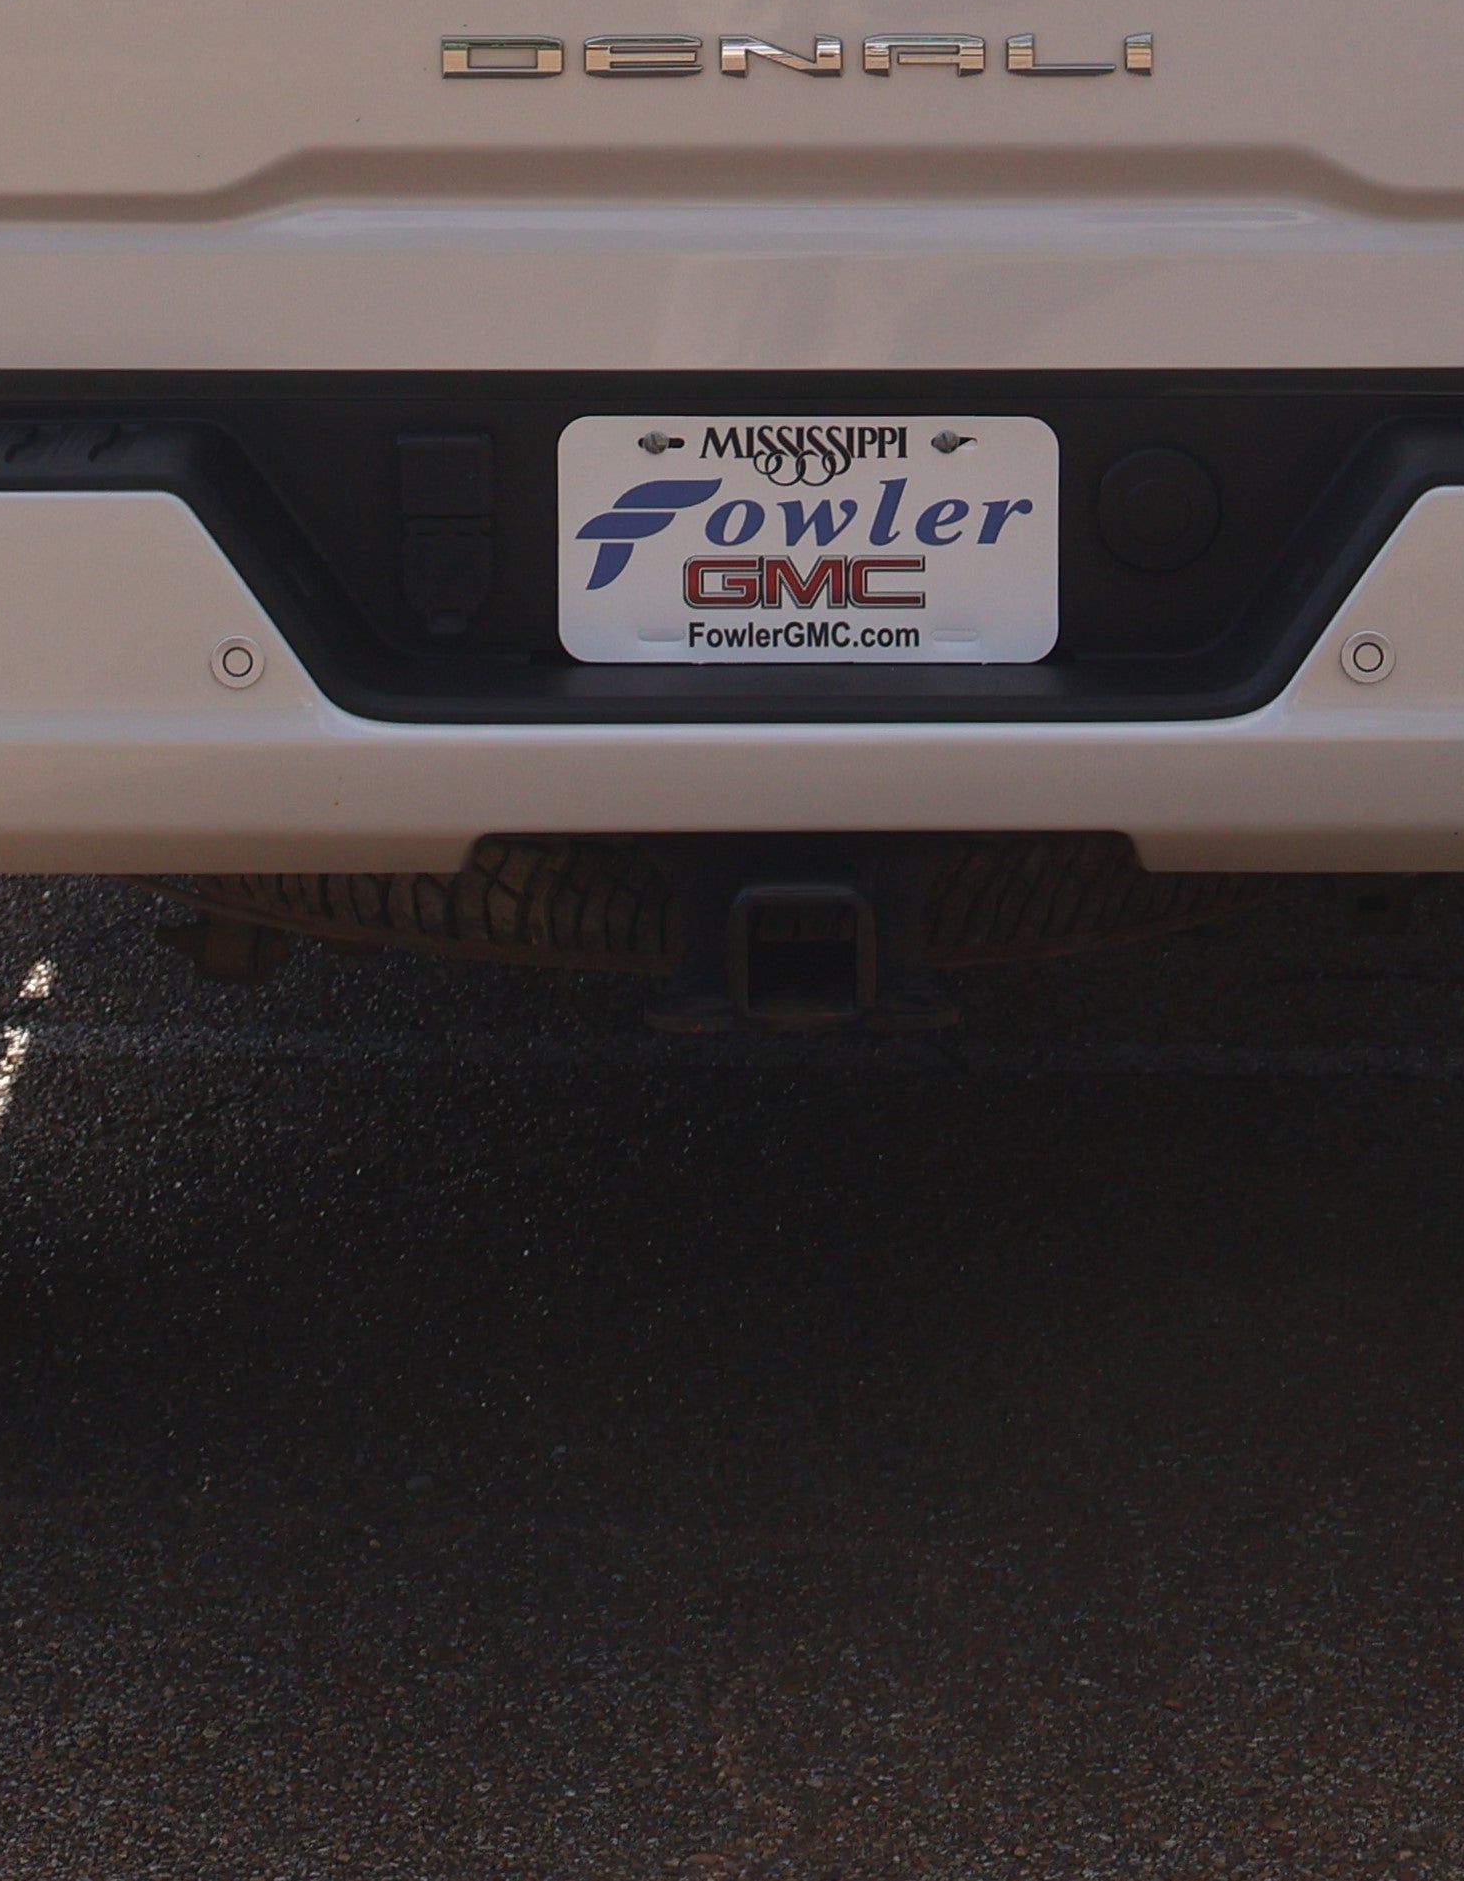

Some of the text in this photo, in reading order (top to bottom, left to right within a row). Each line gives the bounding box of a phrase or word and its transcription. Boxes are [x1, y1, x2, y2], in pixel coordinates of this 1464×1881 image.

[440, 33, 1154, 79] DENALI
[575, 477, 1034, 590] Fowler
[682, 554, 926, 609] GMC
[688, 622, 920, 649] FowlerGMC.com
